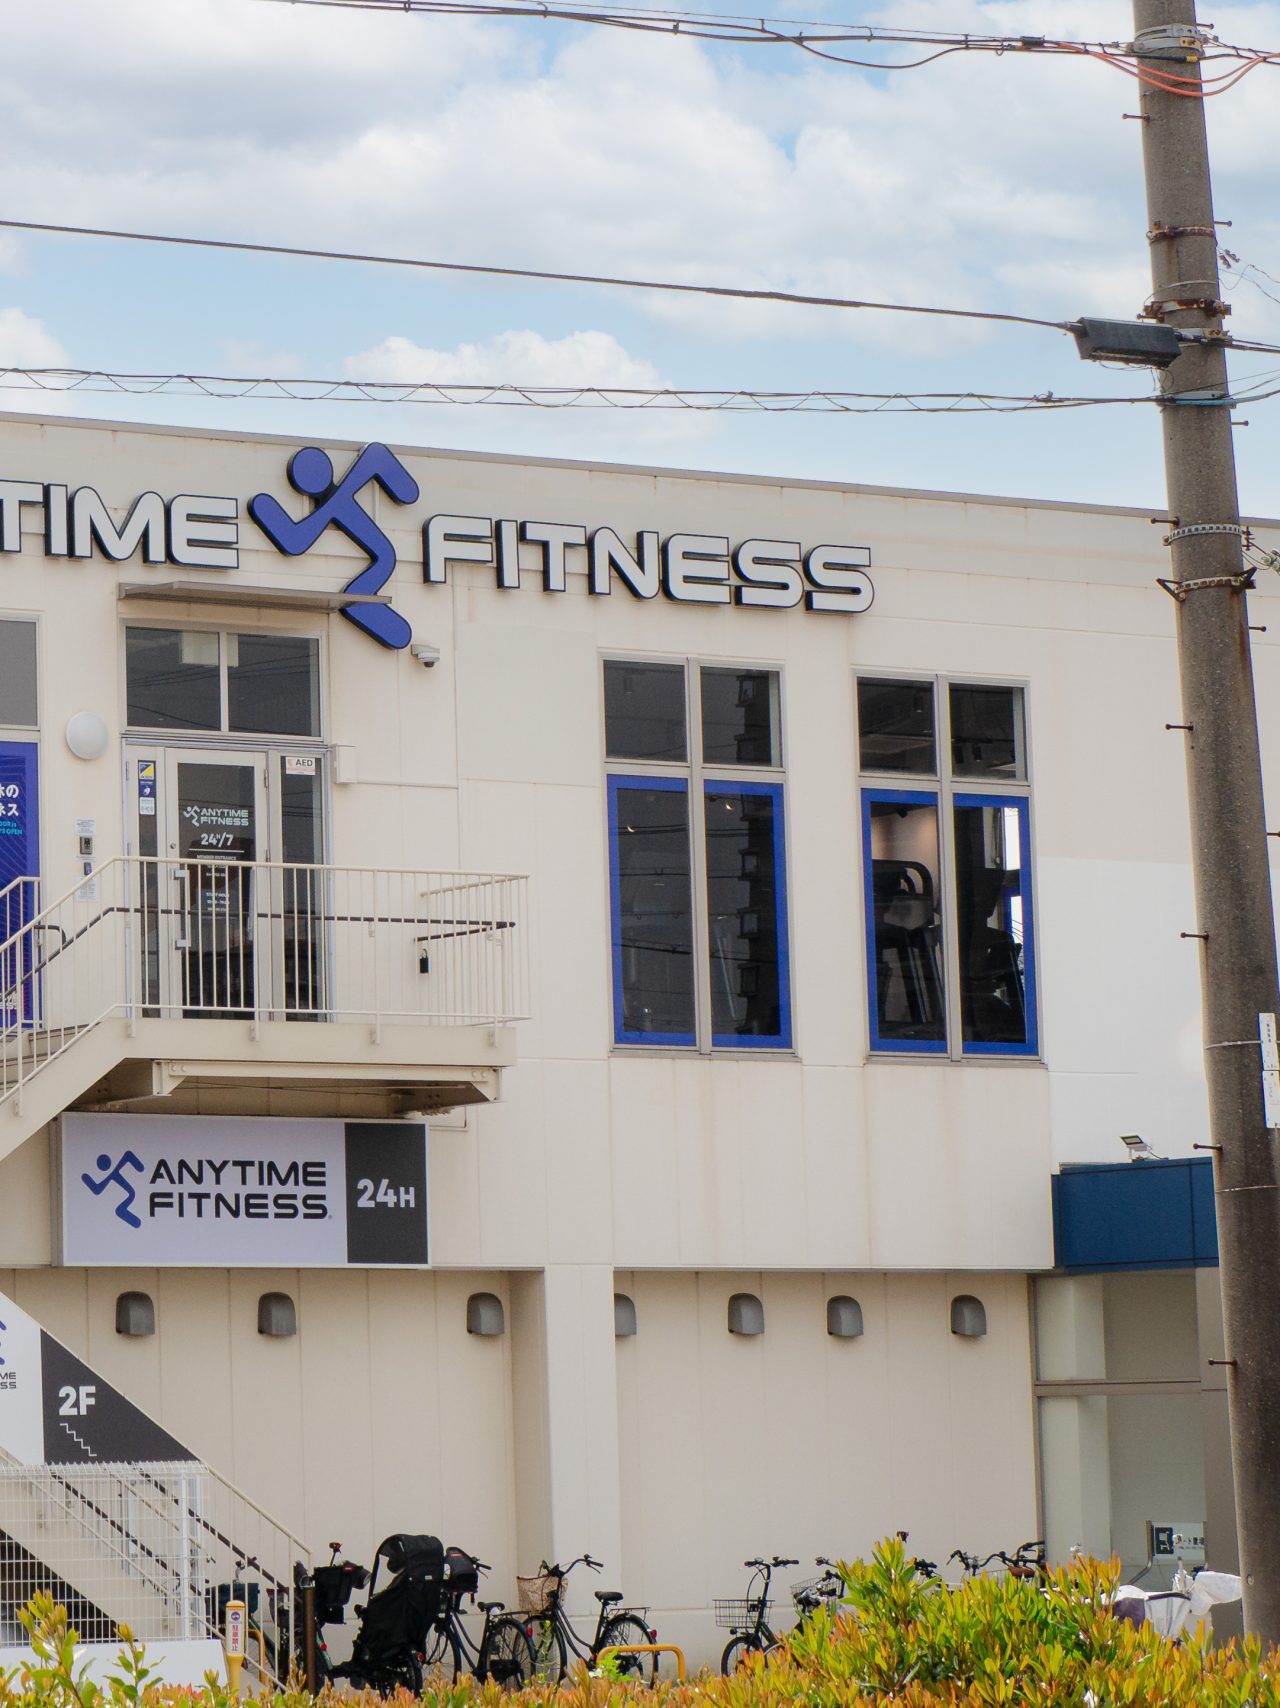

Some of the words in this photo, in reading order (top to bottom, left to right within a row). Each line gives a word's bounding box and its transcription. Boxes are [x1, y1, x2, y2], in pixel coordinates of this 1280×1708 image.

[423, 514, 875, 613] FITNESS
[296, 758, 313, 767] AED
[200, 807, 249, 818] ANYTIME
[200, 816, 249, 826] FITNESS
[149, 1158, 327, 1187] ANYTIME
[356, 1178, 415, 1208] 24H
[149, 1192, 328, 1219] FITNESS
[58, 1386, 96, 1416] 2F
